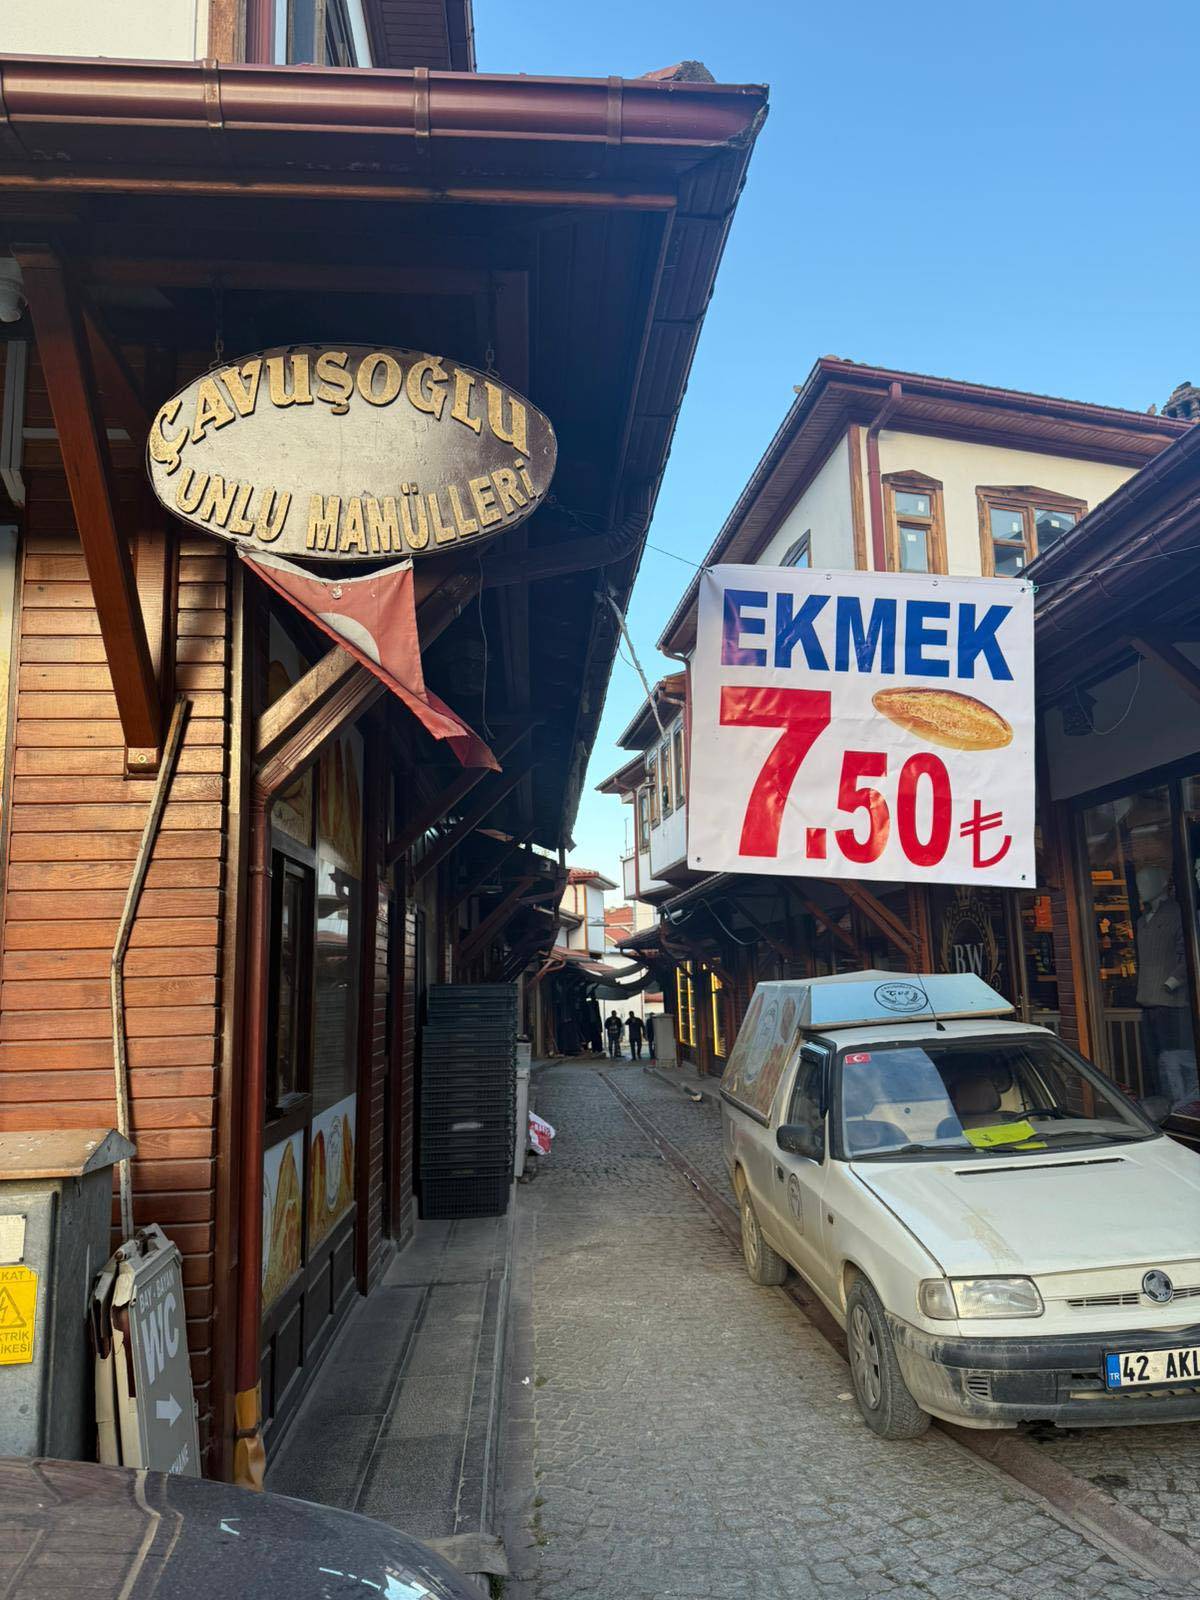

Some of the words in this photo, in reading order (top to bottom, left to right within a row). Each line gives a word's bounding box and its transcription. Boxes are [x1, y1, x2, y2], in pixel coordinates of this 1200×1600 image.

[175, 466, 293, 542] UNLU
[305, 459, 537, 554] MAMÜLLERİ
[720, 588, 1015, 681] EKMEK
[140, 1292, 180, 1385] WC
[1109, 1372, 1120, 1381] TR
[1123, 1355, 1150, 1382] 42
